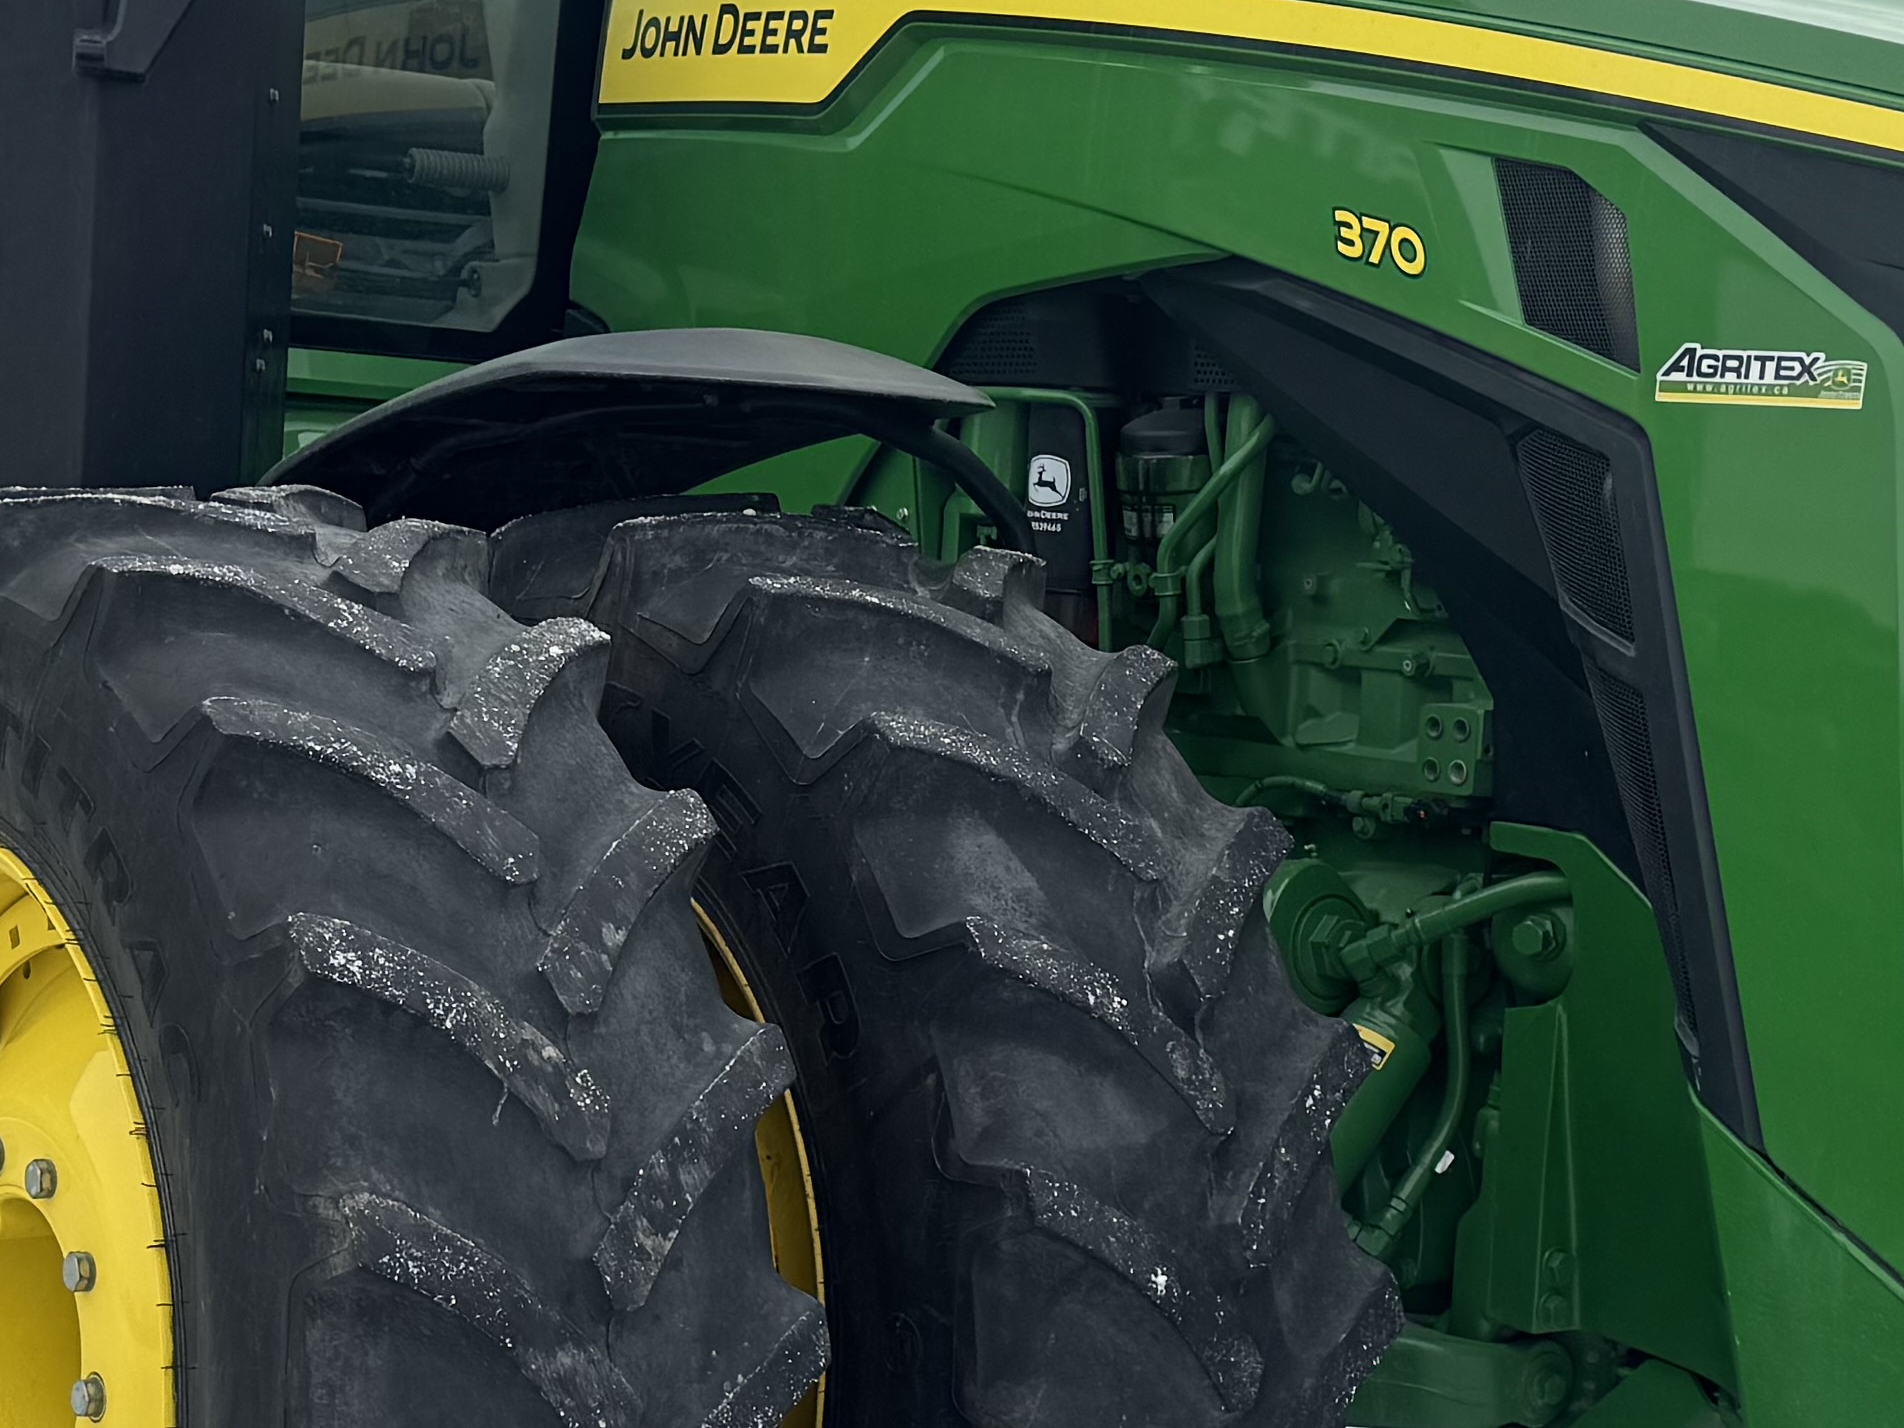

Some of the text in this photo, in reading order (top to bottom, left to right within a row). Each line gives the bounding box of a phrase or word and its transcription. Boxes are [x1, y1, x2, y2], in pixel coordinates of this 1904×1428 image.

[621, 3, 835, 60] JOHN DEERE
[1332, 207, 1427, 278] 370
[1660, 347, 1822, 383] AGRITEX
[1686, 383, 1790, 396] www.agritex.ca
